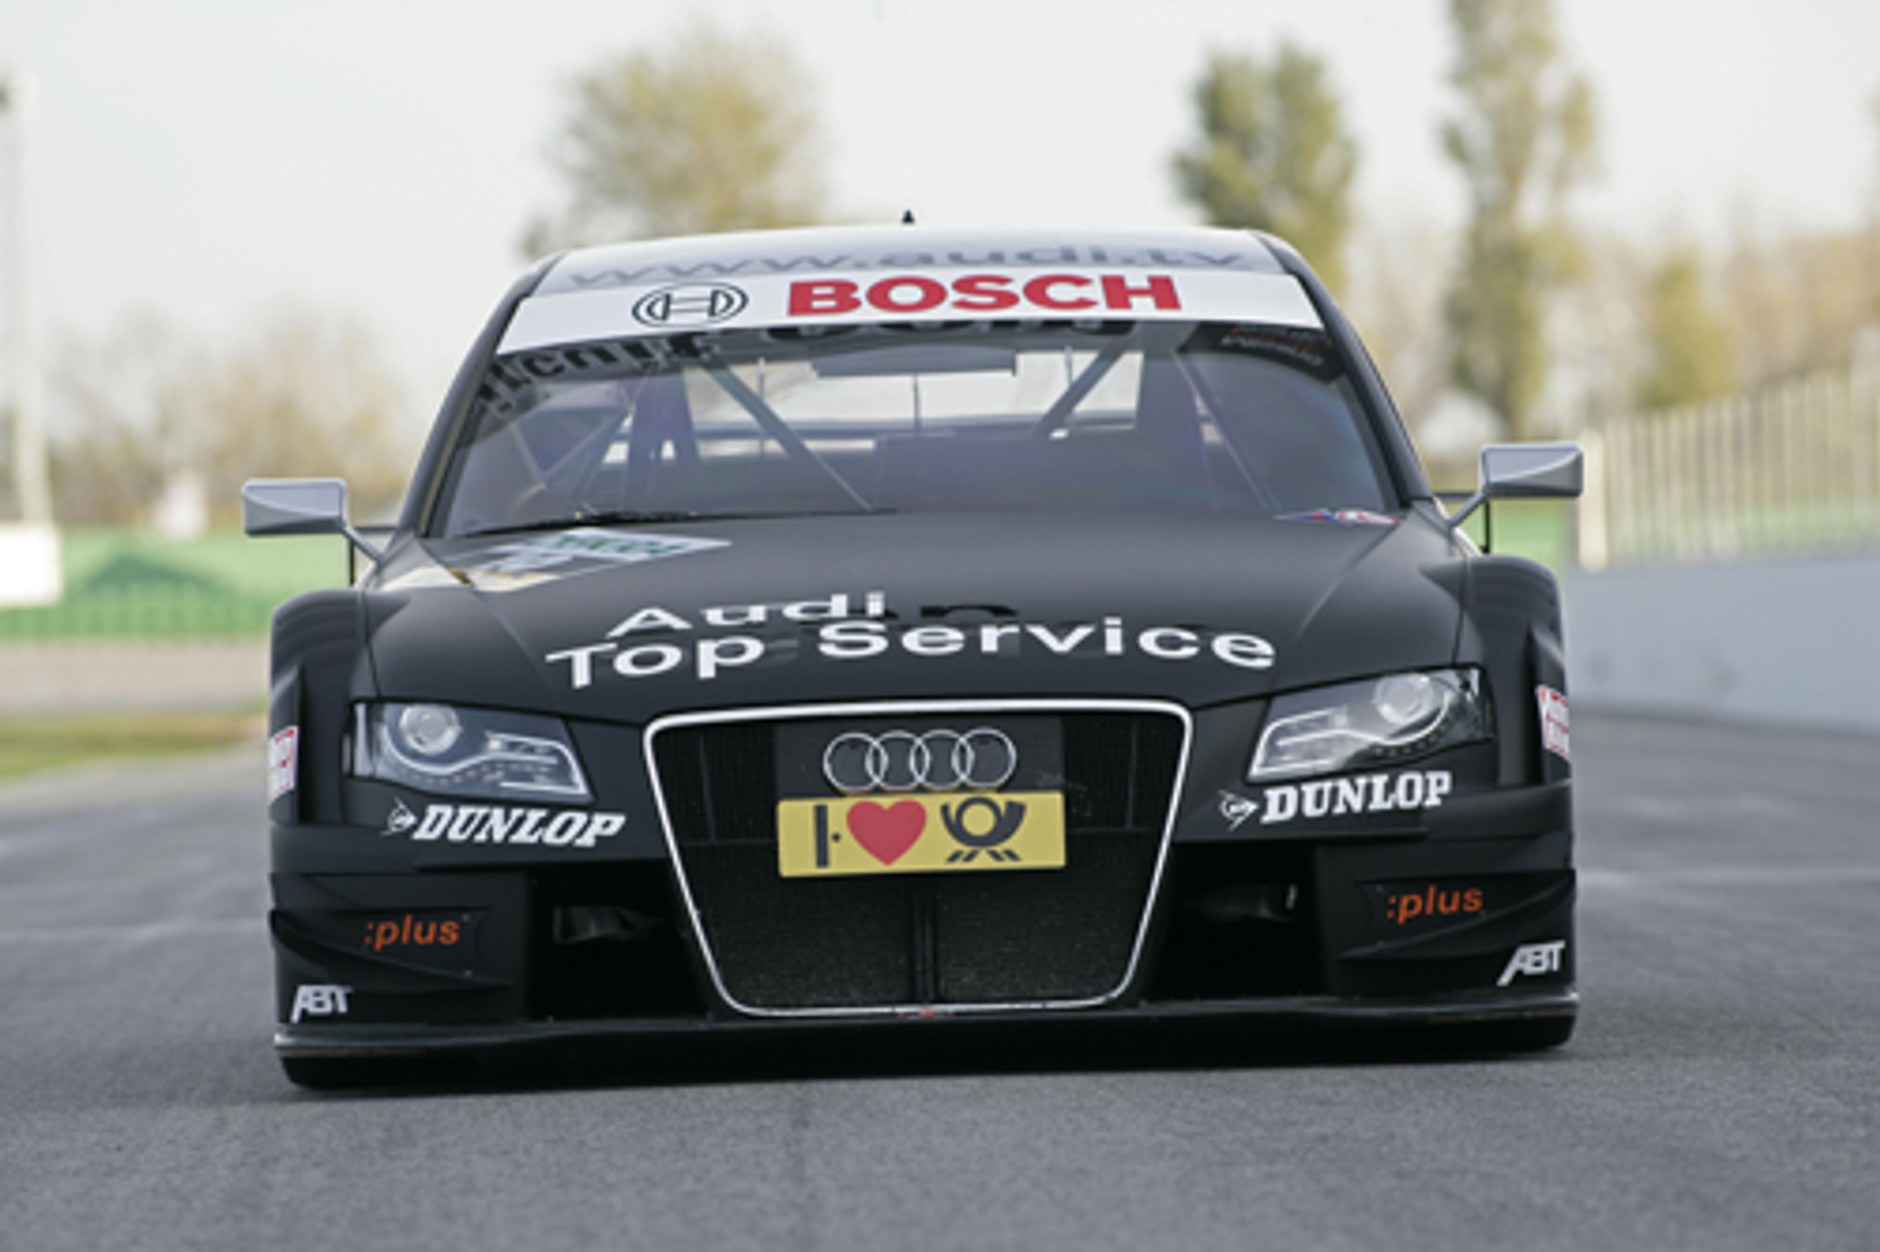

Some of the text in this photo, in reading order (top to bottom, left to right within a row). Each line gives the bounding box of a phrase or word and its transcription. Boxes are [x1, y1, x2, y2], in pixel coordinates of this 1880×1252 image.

[570, 245, 1242, 285] www.audi.tv
[789, 274, 1181, 316] BOSCH
[606, 592, 885, 638] Audi
[546, 616, 1275, 689] Top Service
[1259, 770, 1452, 824] DUNLOP
[411, 804, 626, 847] DUNLOP
[1497, 940, 1565, 986] ABT
[291, 984, 354, 1024] ABT
